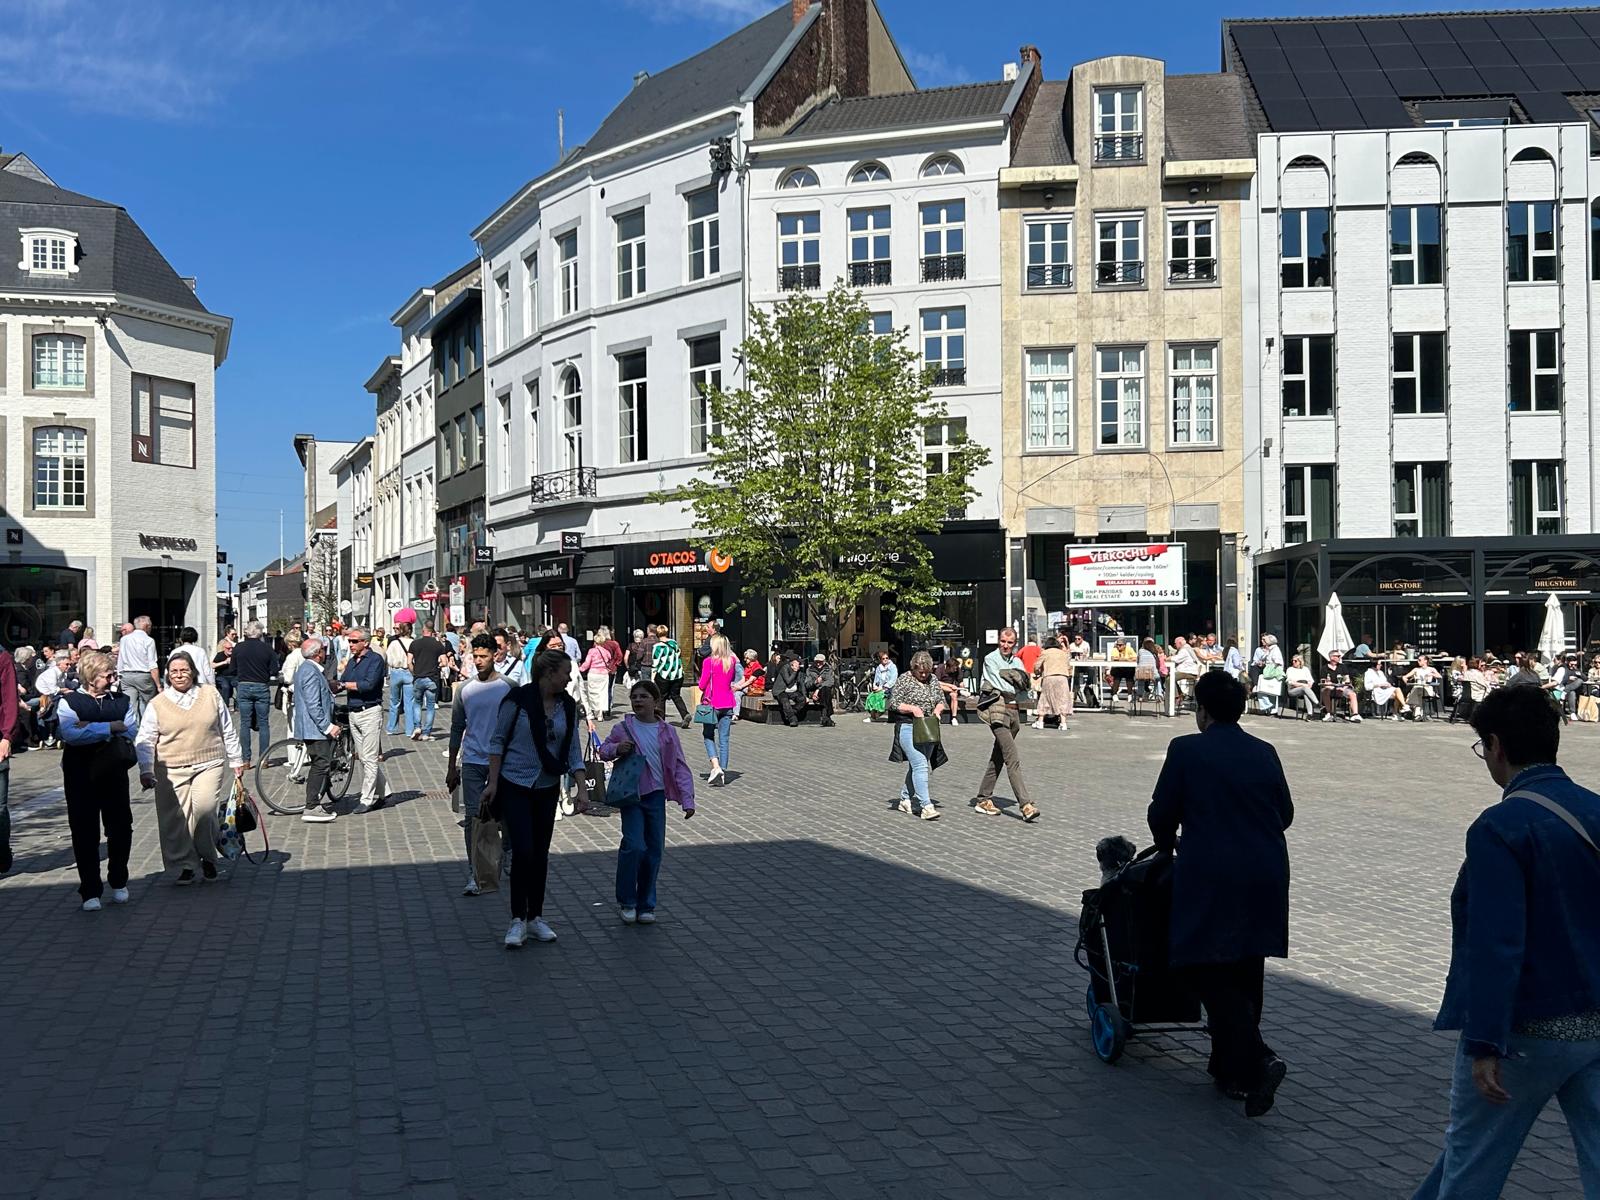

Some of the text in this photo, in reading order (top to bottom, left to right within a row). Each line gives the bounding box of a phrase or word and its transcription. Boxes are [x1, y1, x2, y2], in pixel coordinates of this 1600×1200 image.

[650, 551, 696, 566] O'TACOS
[1089, 548, 1148, 563] VERKOCHT!
[633, 568, 645, 576] THE
[645, 566, 672, 575] ORIGINAL
[673, 564, 697, 573] FRENCH
